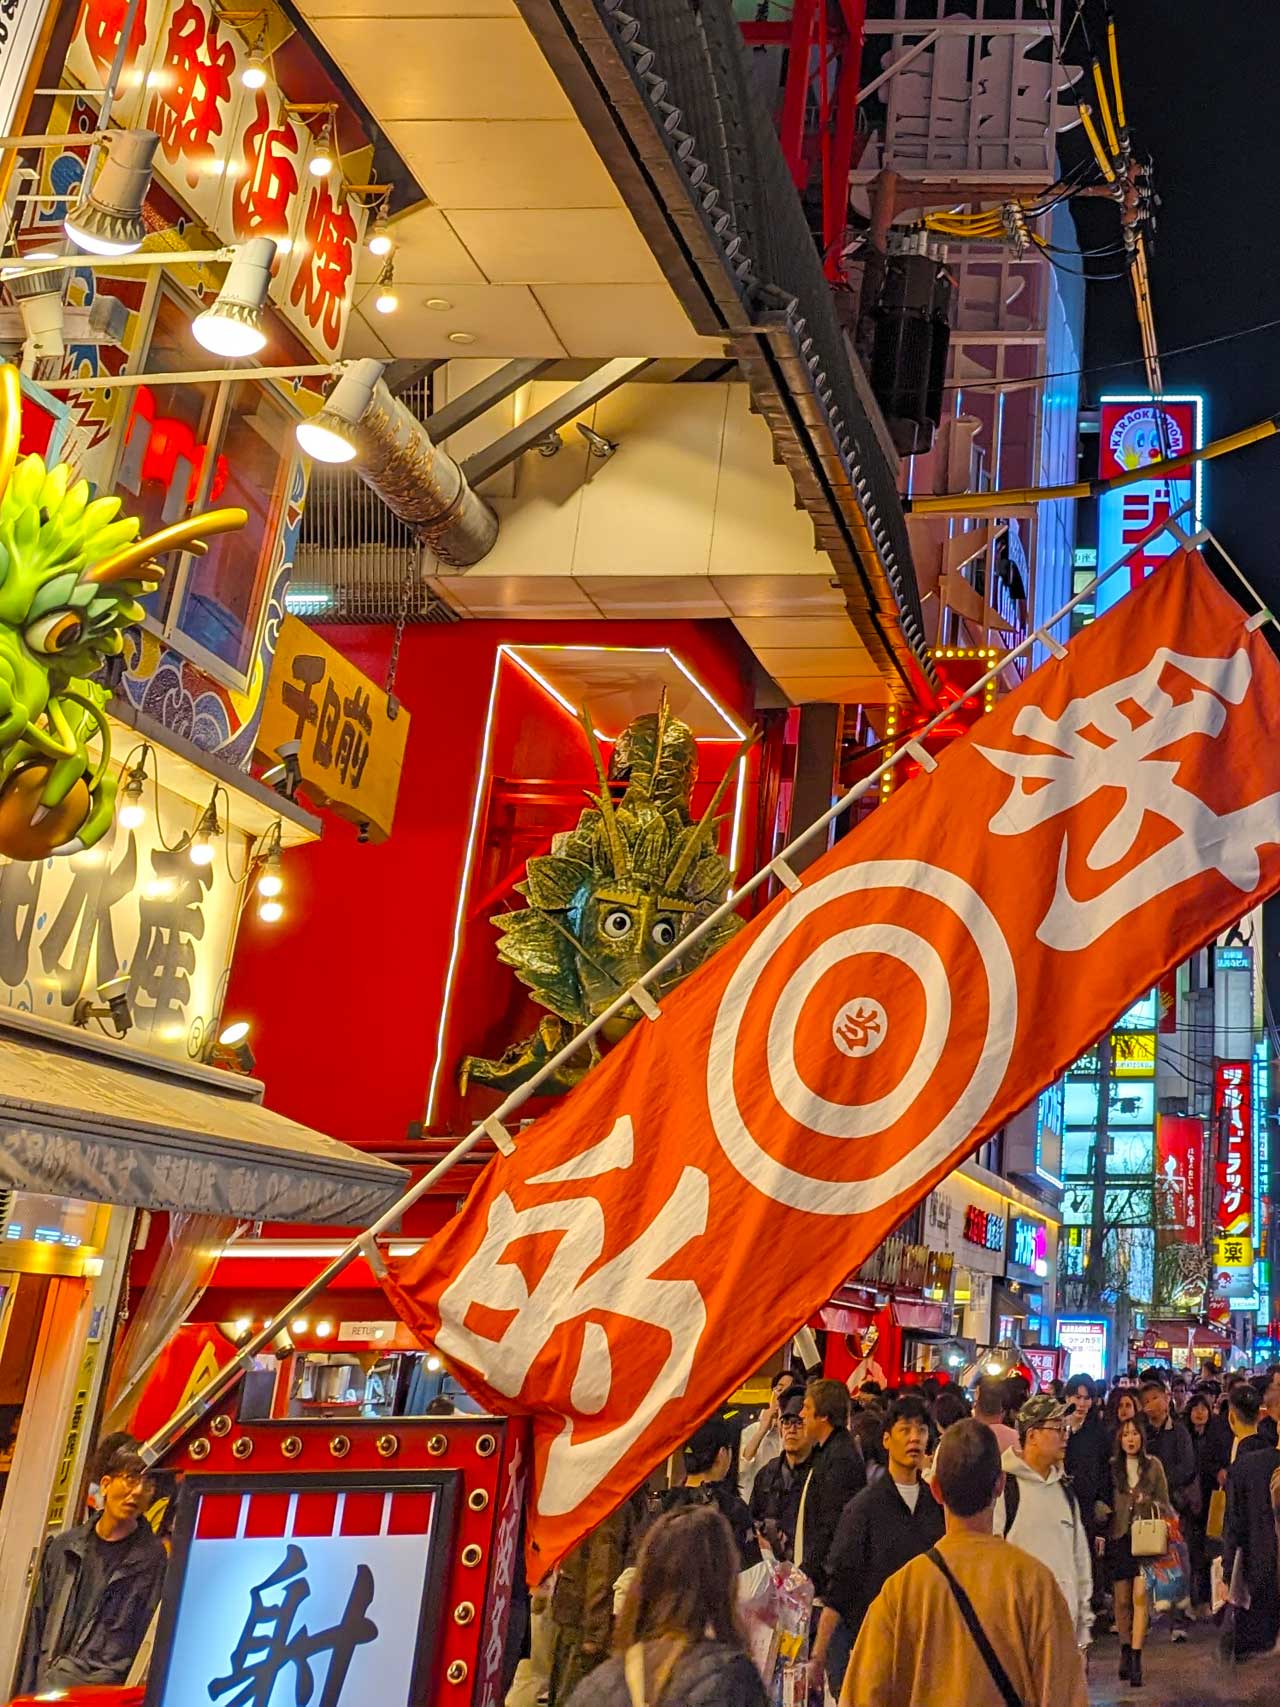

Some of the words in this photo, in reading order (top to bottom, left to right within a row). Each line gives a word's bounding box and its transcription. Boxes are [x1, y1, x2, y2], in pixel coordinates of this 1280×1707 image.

[1110, 407, 1157, 449] KARAOK
[281, 654, 374, 791] 千日前
[1223, 1241, 1243, 1263] 薬
[208, 1544, 378, 1707] 射
